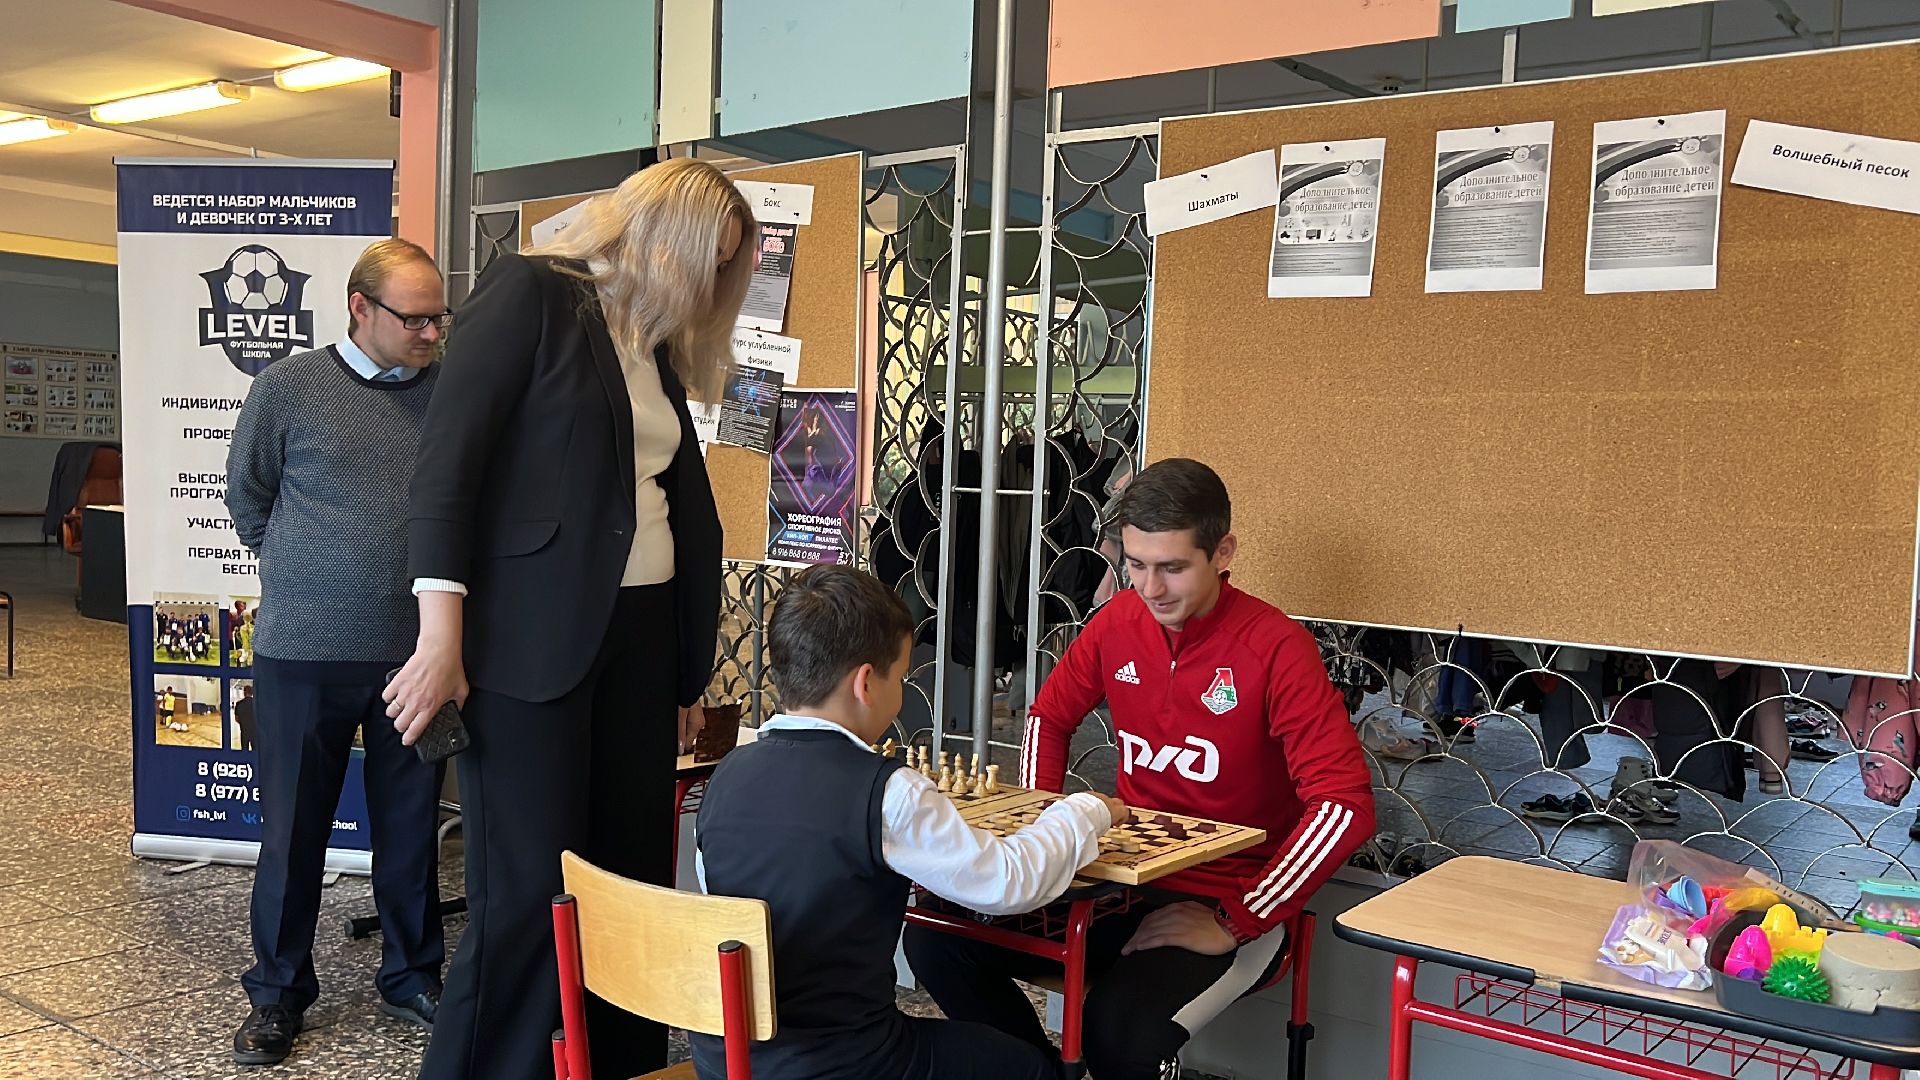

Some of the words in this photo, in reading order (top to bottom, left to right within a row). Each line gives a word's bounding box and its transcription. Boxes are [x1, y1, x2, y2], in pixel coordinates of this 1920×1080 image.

[1772, 144, 1863, 171] Волшебный
[1865, 162, 1910, 178] песок
[1459, 173, 1538, 188] Дополнительное
[1620, 165, 1711, 182] Дополнительное
[1300, 186, 1371, 198] Дополнительное
[1454, 190, 1513, 204] образование
[1615, 184, 1682, 199] образование
[152, 194, 215, 208] ВЕДЕТСЯ
[218, 194, 266, 208] НАБОР
[269, 195, 357, 209] МАЛЬЧИКОВ
[763, 197, 781, 208] Бокс
[1187, 191, 1239, 212] Шахматы
[1295, 201, 1347, 214] образование
[176, 212, 187, 224] И
[189, 212, 255, 225] ДЕВОЧЕК
[258, 213, 276, 225] ОТ
[279, 213, 303, 225] 3-Х
[305, 213, 333, 226] ЛЕТ
[207, 313, 308, 341] LEVEL
[230, 341, 284, 349] ФУТБОЛЬНАЯ
[242, 350, 271, 358] ШКОЛА
[787, 512, 842, 526] ХОРЕОГРАФИЯ
[188, 547, 241, 560] ПЕРВАЯ
[1114, 672, 1141, 685] adidas
[198, 761, 209, 776] 8
[213, 761, 253, 782] (926)
[195, 783, 207, 797] 8
[210, 782, 249, 804] (977)
[193, 809, 227, 821] fsh_lvl
